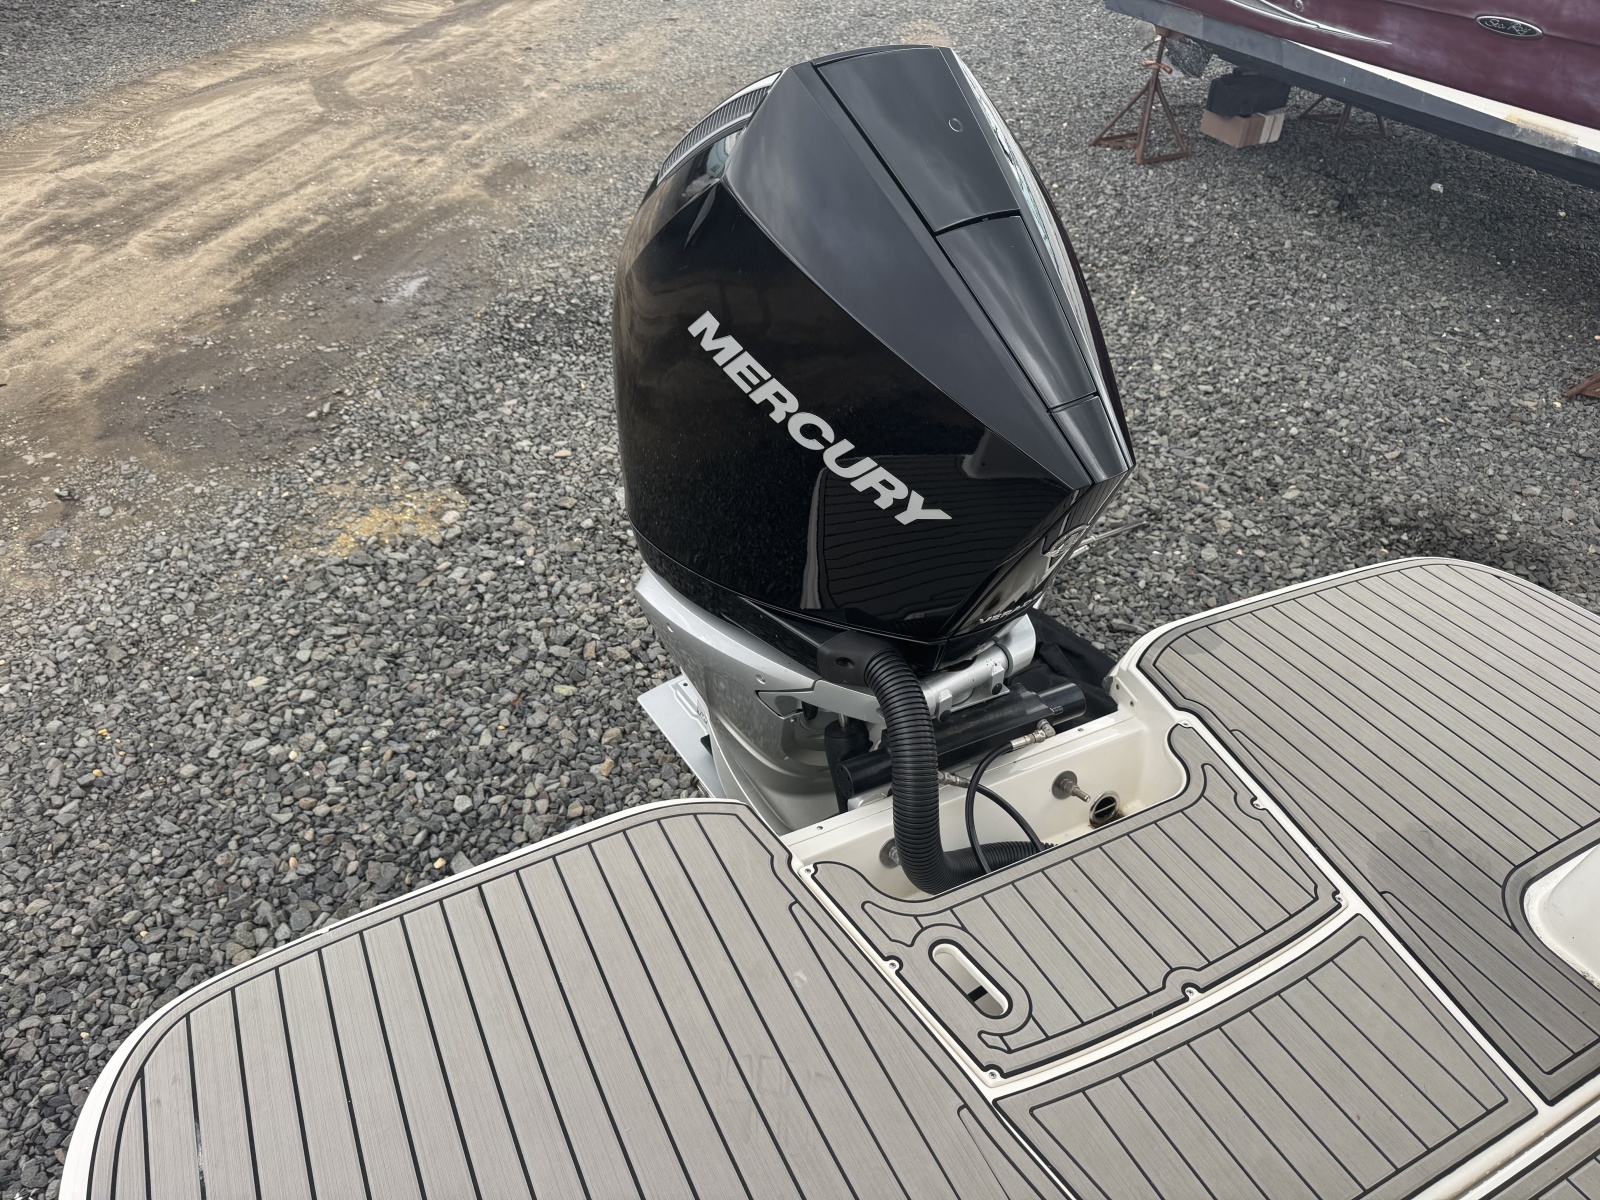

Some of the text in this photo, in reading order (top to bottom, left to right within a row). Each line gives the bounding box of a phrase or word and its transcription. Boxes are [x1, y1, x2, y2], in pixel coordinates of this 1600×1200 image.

[1484, 18, 1531, 35] Sea Ray
[687, 310, 952, 525] MERCURY
